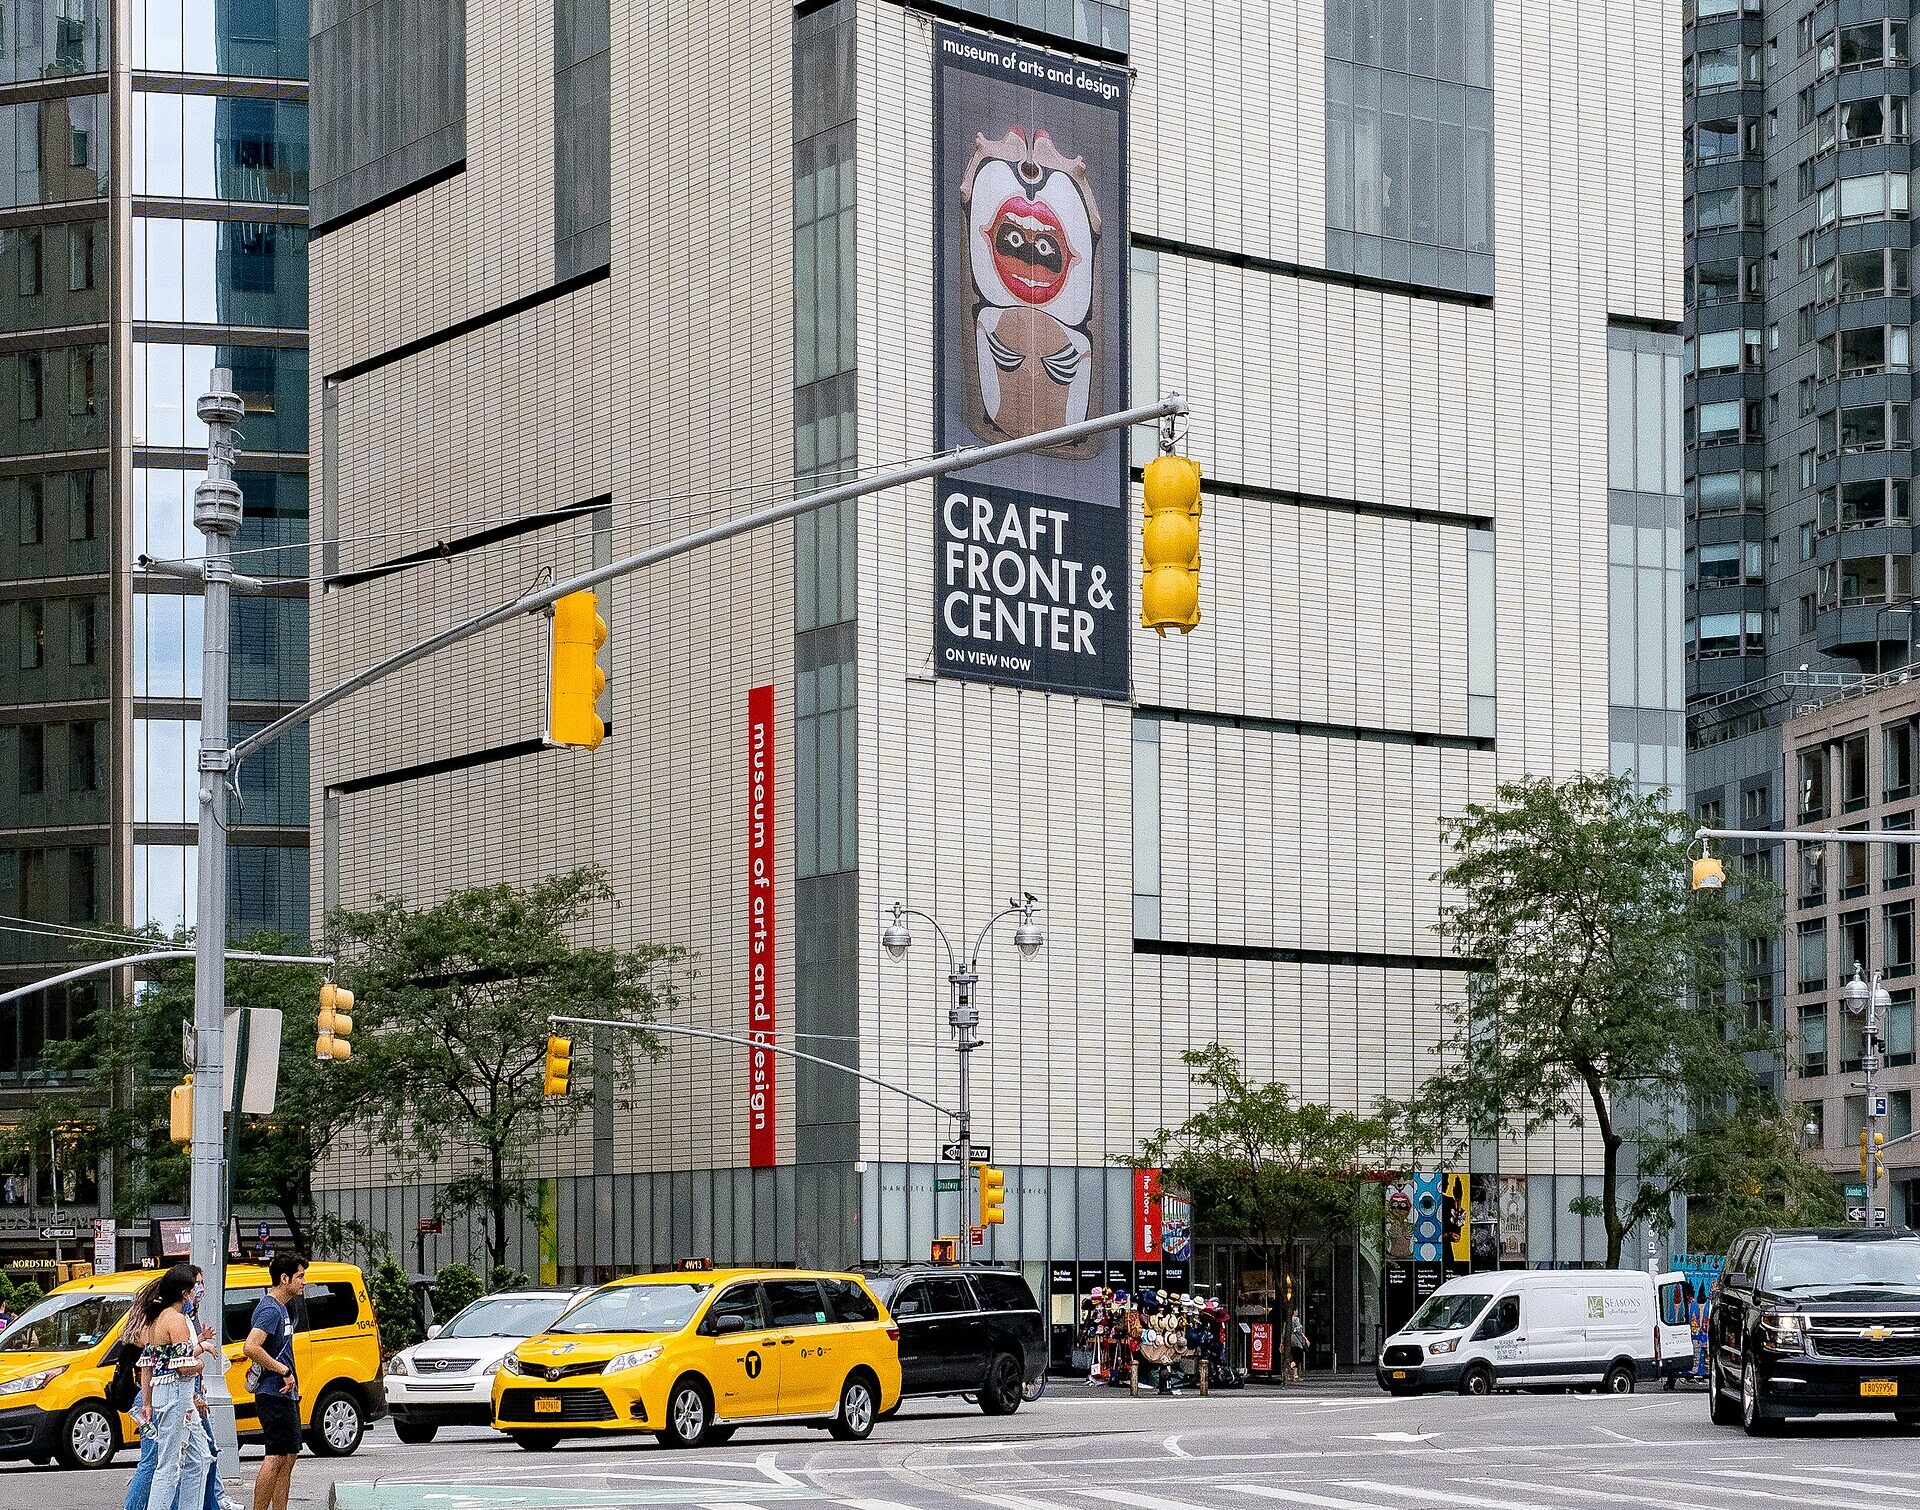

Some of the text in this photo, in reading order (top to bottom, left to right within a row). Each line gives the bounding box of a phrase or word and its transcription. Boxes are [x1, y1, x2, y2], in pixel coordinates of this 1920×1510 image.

[943, 39, 1120, 100] museum of arts and design
[943, 492, 1069, 555] CRAFT
[946, 541, 1116, 611] FRONT &
[943, 590, 1097, 656] CENTER
[945, 648, 1032, 671] ON VIEW NOW
[750, 723, 771, 1130] museum of arts and design
[937, 1180, 959, 1191] Broadway
[12, 1259, 56, 1269] NORDSTRO
[685, 1260, 702, 1270] 4W13
[1604, 1297, 1641, 1309] SEASONS
[356, 1319, 375, 1330] 1G94
[748, 1355, 758, 1376] T
